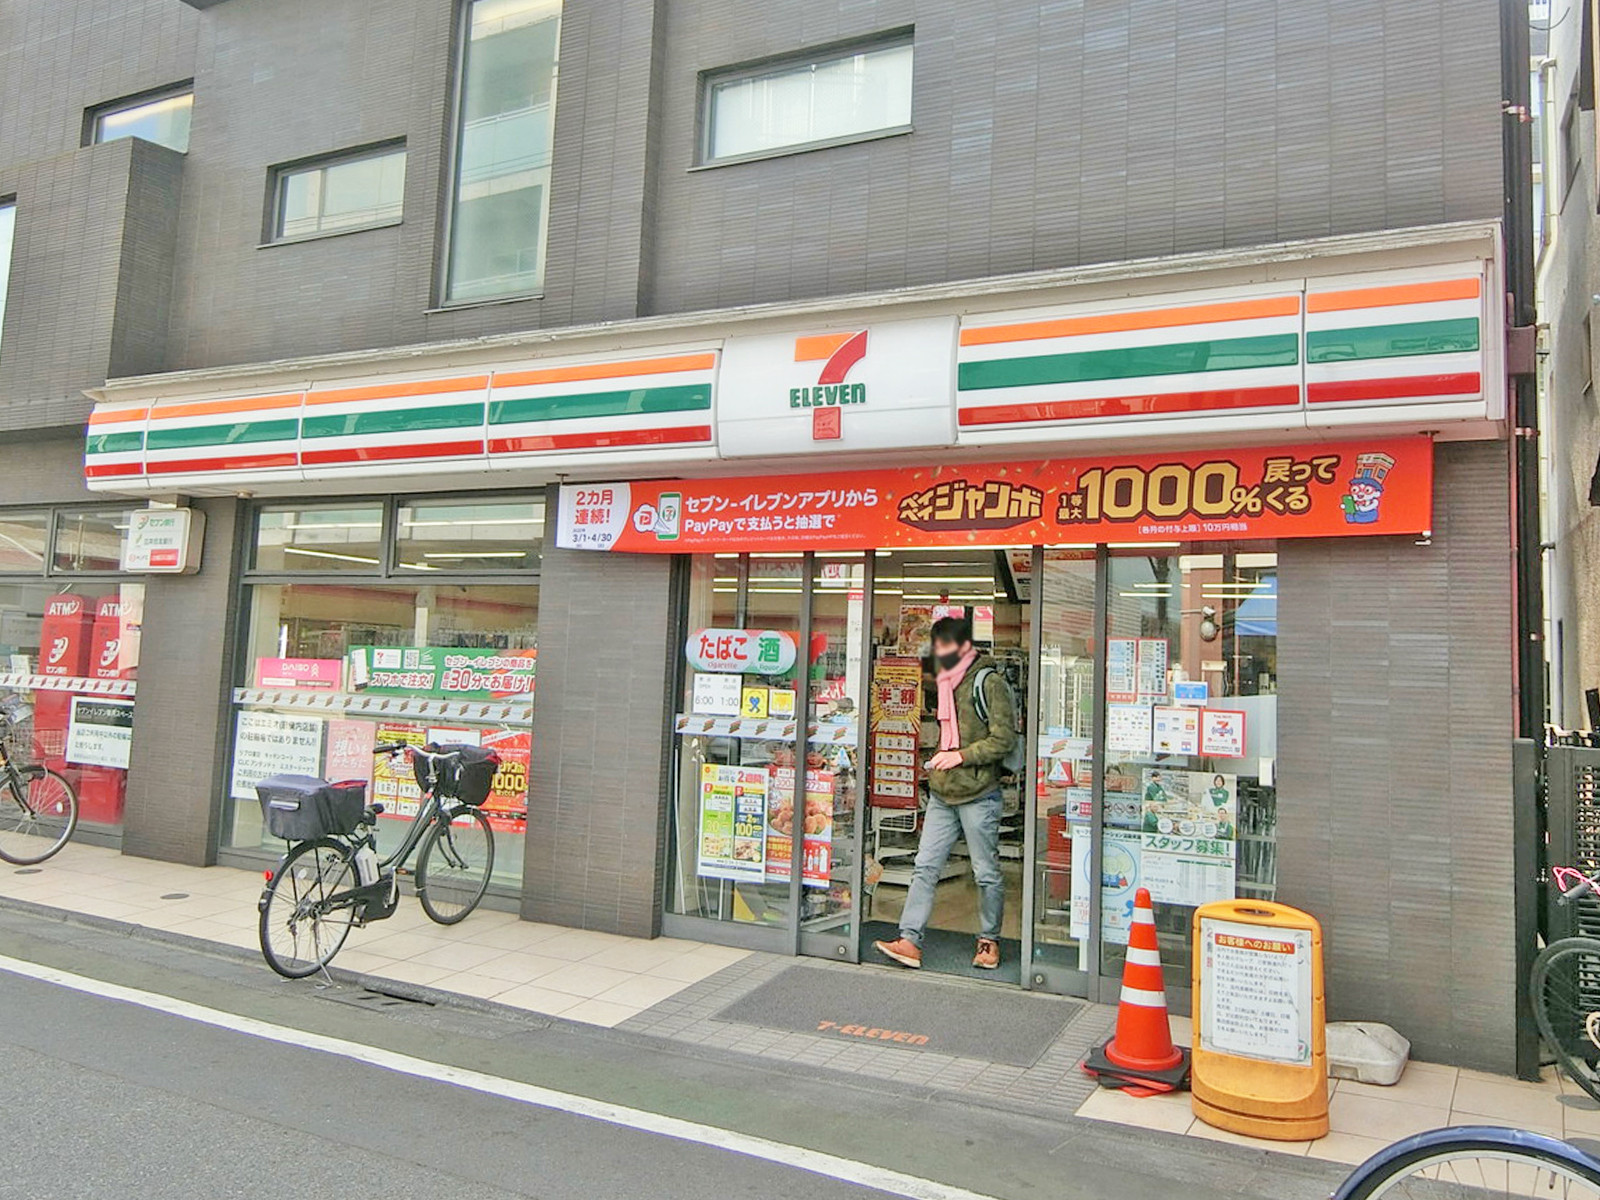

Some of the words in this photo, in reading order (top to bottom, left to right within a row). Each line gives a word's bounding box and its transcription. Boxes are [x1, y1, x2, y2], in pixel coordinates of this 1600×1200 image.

[794, 330, 868, 385] 7
[1264, 457, 1338, 483] 戻って
[576, 489, 613, 506] 2カ月
[1266, 486, 1310, 511] くる
[574, 508, 610, 525] 連続!
[1058, 507, 1083, 520] 最大
[49, 602, 71, 616] ATM
[100, 603, 124, 617] ATM
[699, 635, 749, 660] たばこ
[758, 637, 781, 662] 酒
[1145, 835, 1231, 857] スタッフ募集!
[1218, 934, 1291, 953] お客様へのお願い
